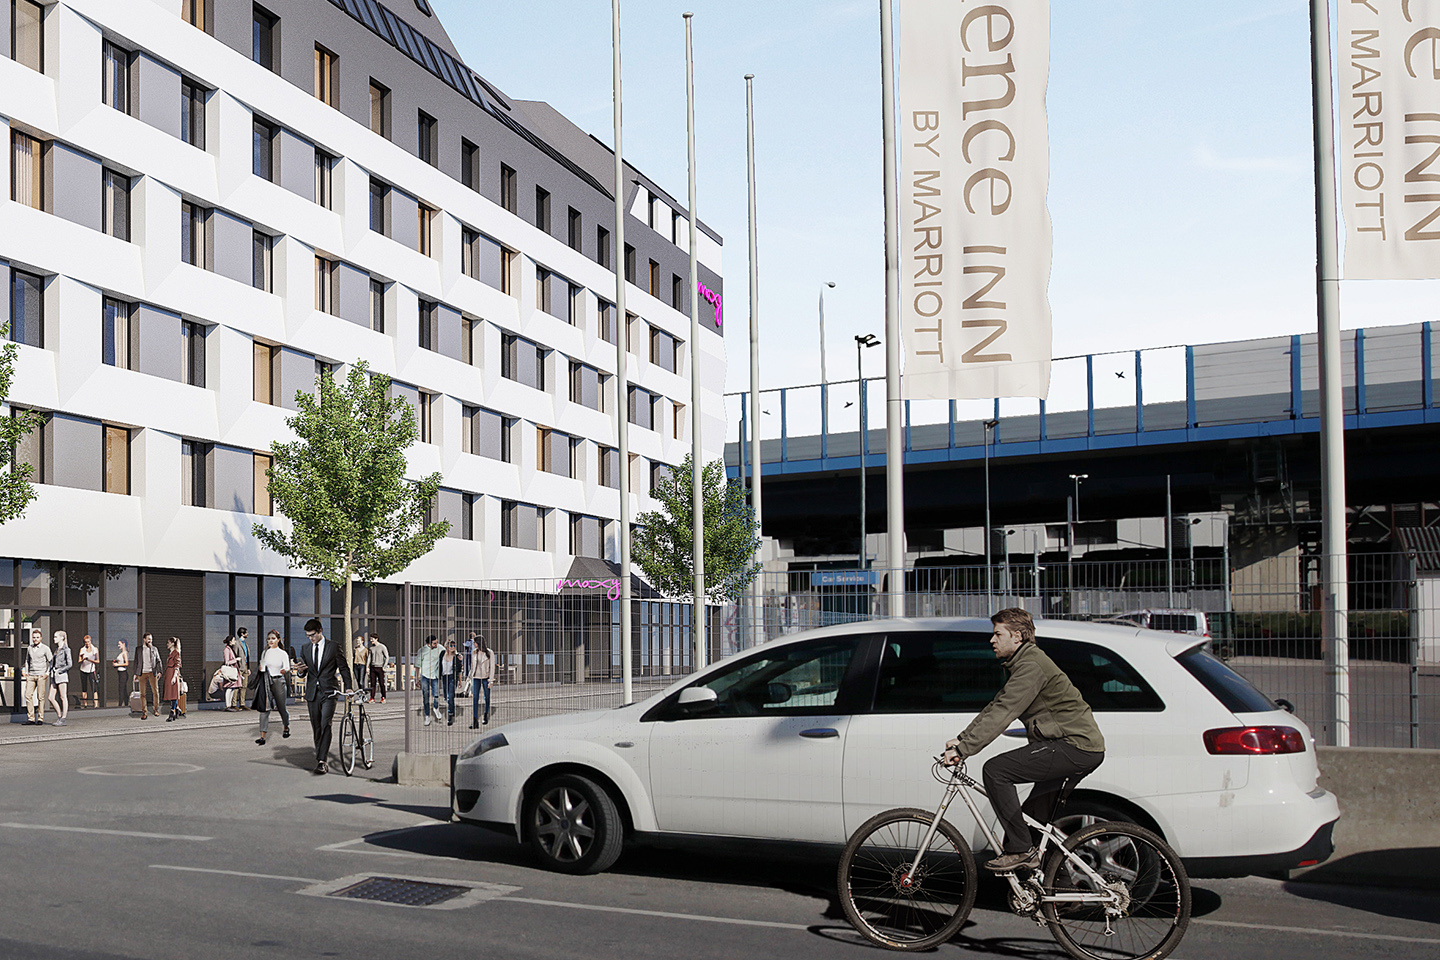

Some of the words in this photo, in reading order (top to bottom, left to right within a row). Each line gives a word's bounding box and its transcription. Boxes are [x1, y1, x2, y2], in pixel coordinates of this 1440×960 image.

[913, 111, 940, 158] BY
[1350, 30, 1386, 241] MARRIOTT
[913, 170, 944, 363] MARRIOTT
[961, 245, 1013, 363] INN
[557, 578, 621, 600] moxy
